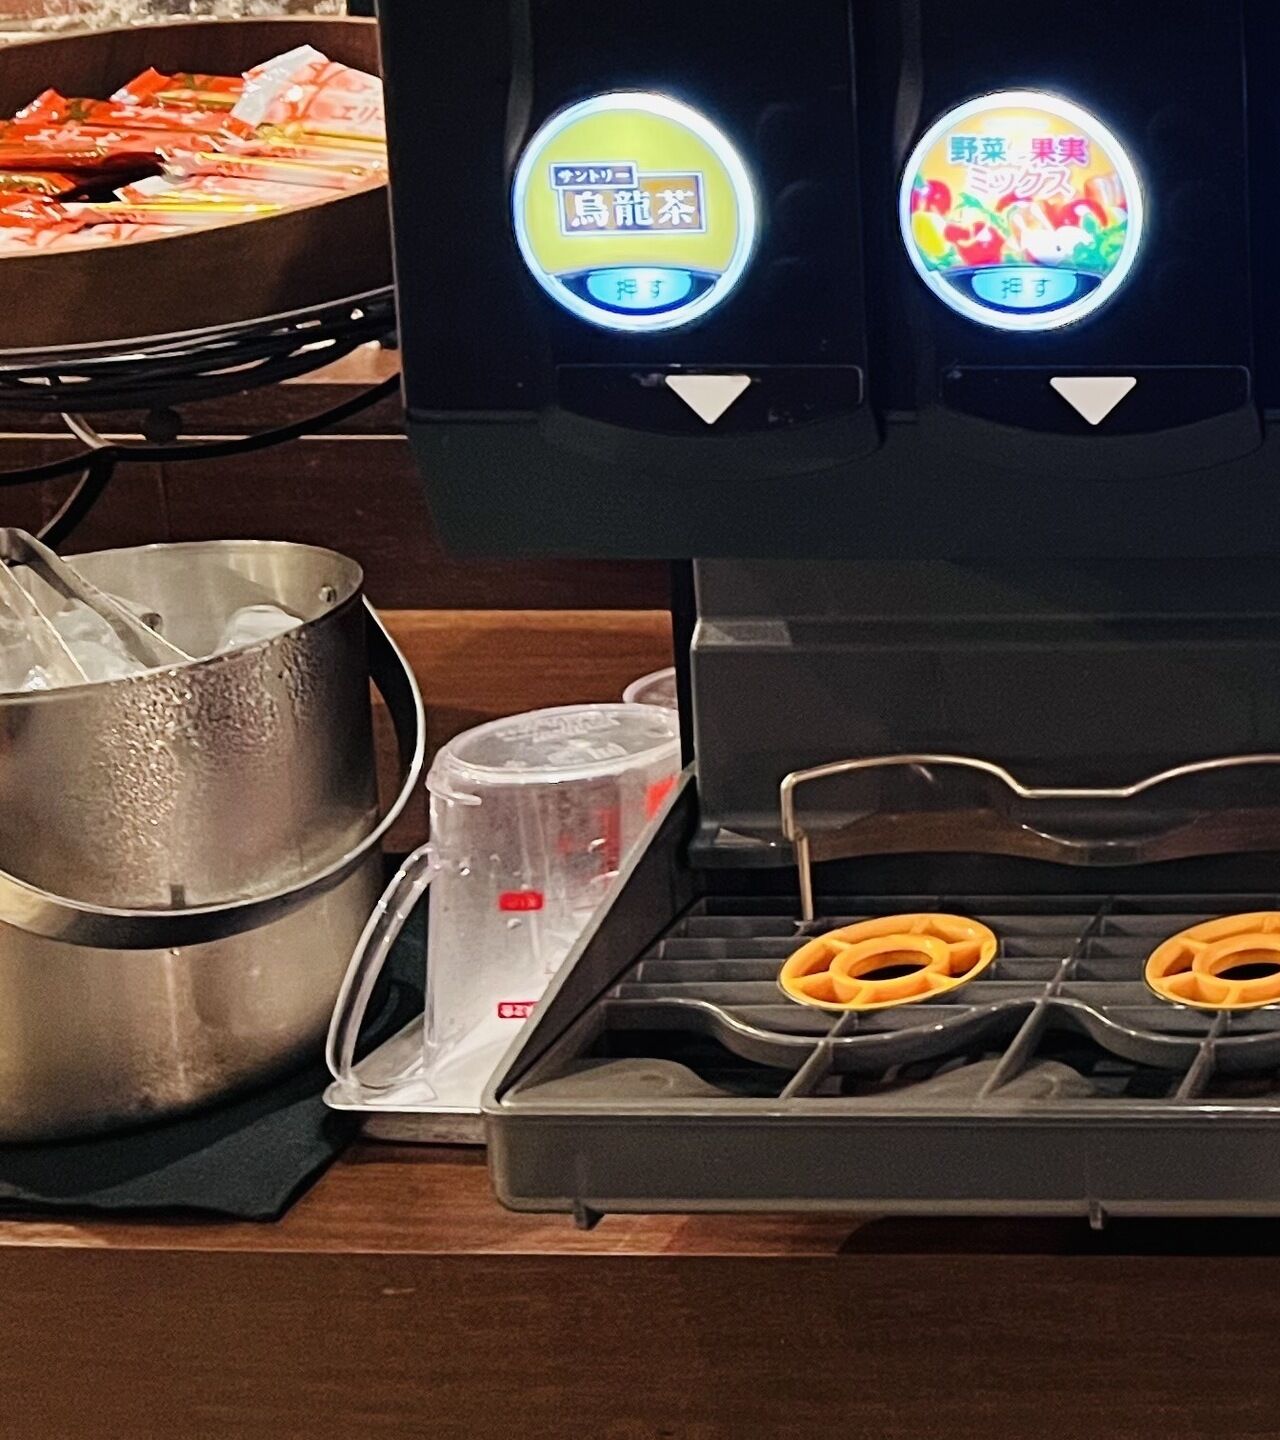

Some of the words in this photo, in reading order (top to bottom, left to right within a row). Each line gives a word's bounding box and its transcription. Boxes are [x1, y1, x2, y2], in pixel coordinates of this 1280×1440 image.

[950, 135, 1007, 164] 野菜
[1030, 136, 1089, 164] 果実
[557, 167, 630, 184] サントリー
[969, 166, 1074, 196] ミックス
[1001, 277, 1051, 299] 押す
